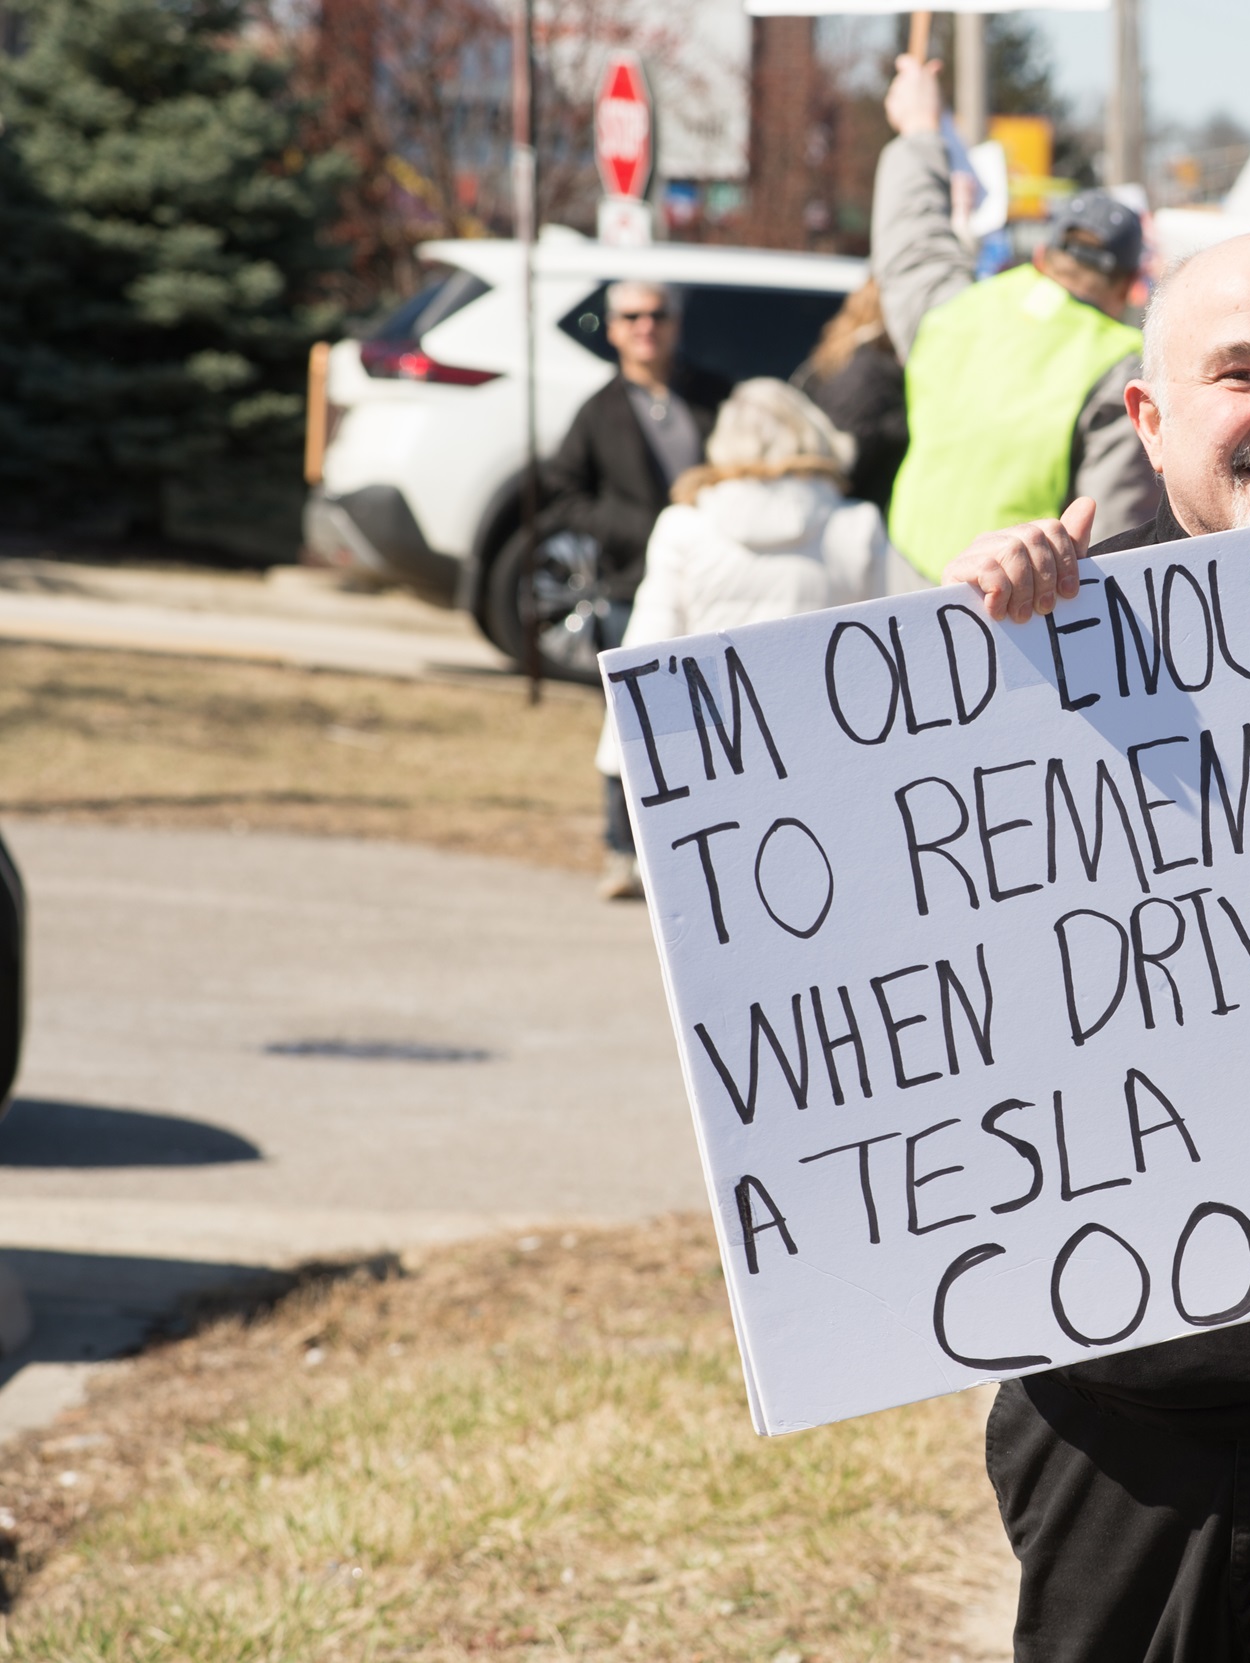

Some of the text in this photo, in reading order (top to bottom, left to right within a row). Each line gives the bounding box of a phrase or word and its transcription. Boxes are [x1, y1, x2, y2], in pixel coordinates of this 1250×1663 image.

[608, 646, 789, 808] I'M
[824, 603, 997, 745] OLD
[671, 817, 834, 945] TO
[694, 942, 995, 1125] WHEN
[734, 1174, 799, 1275] A
[798, 1067, 1202, 1245] TESLA
